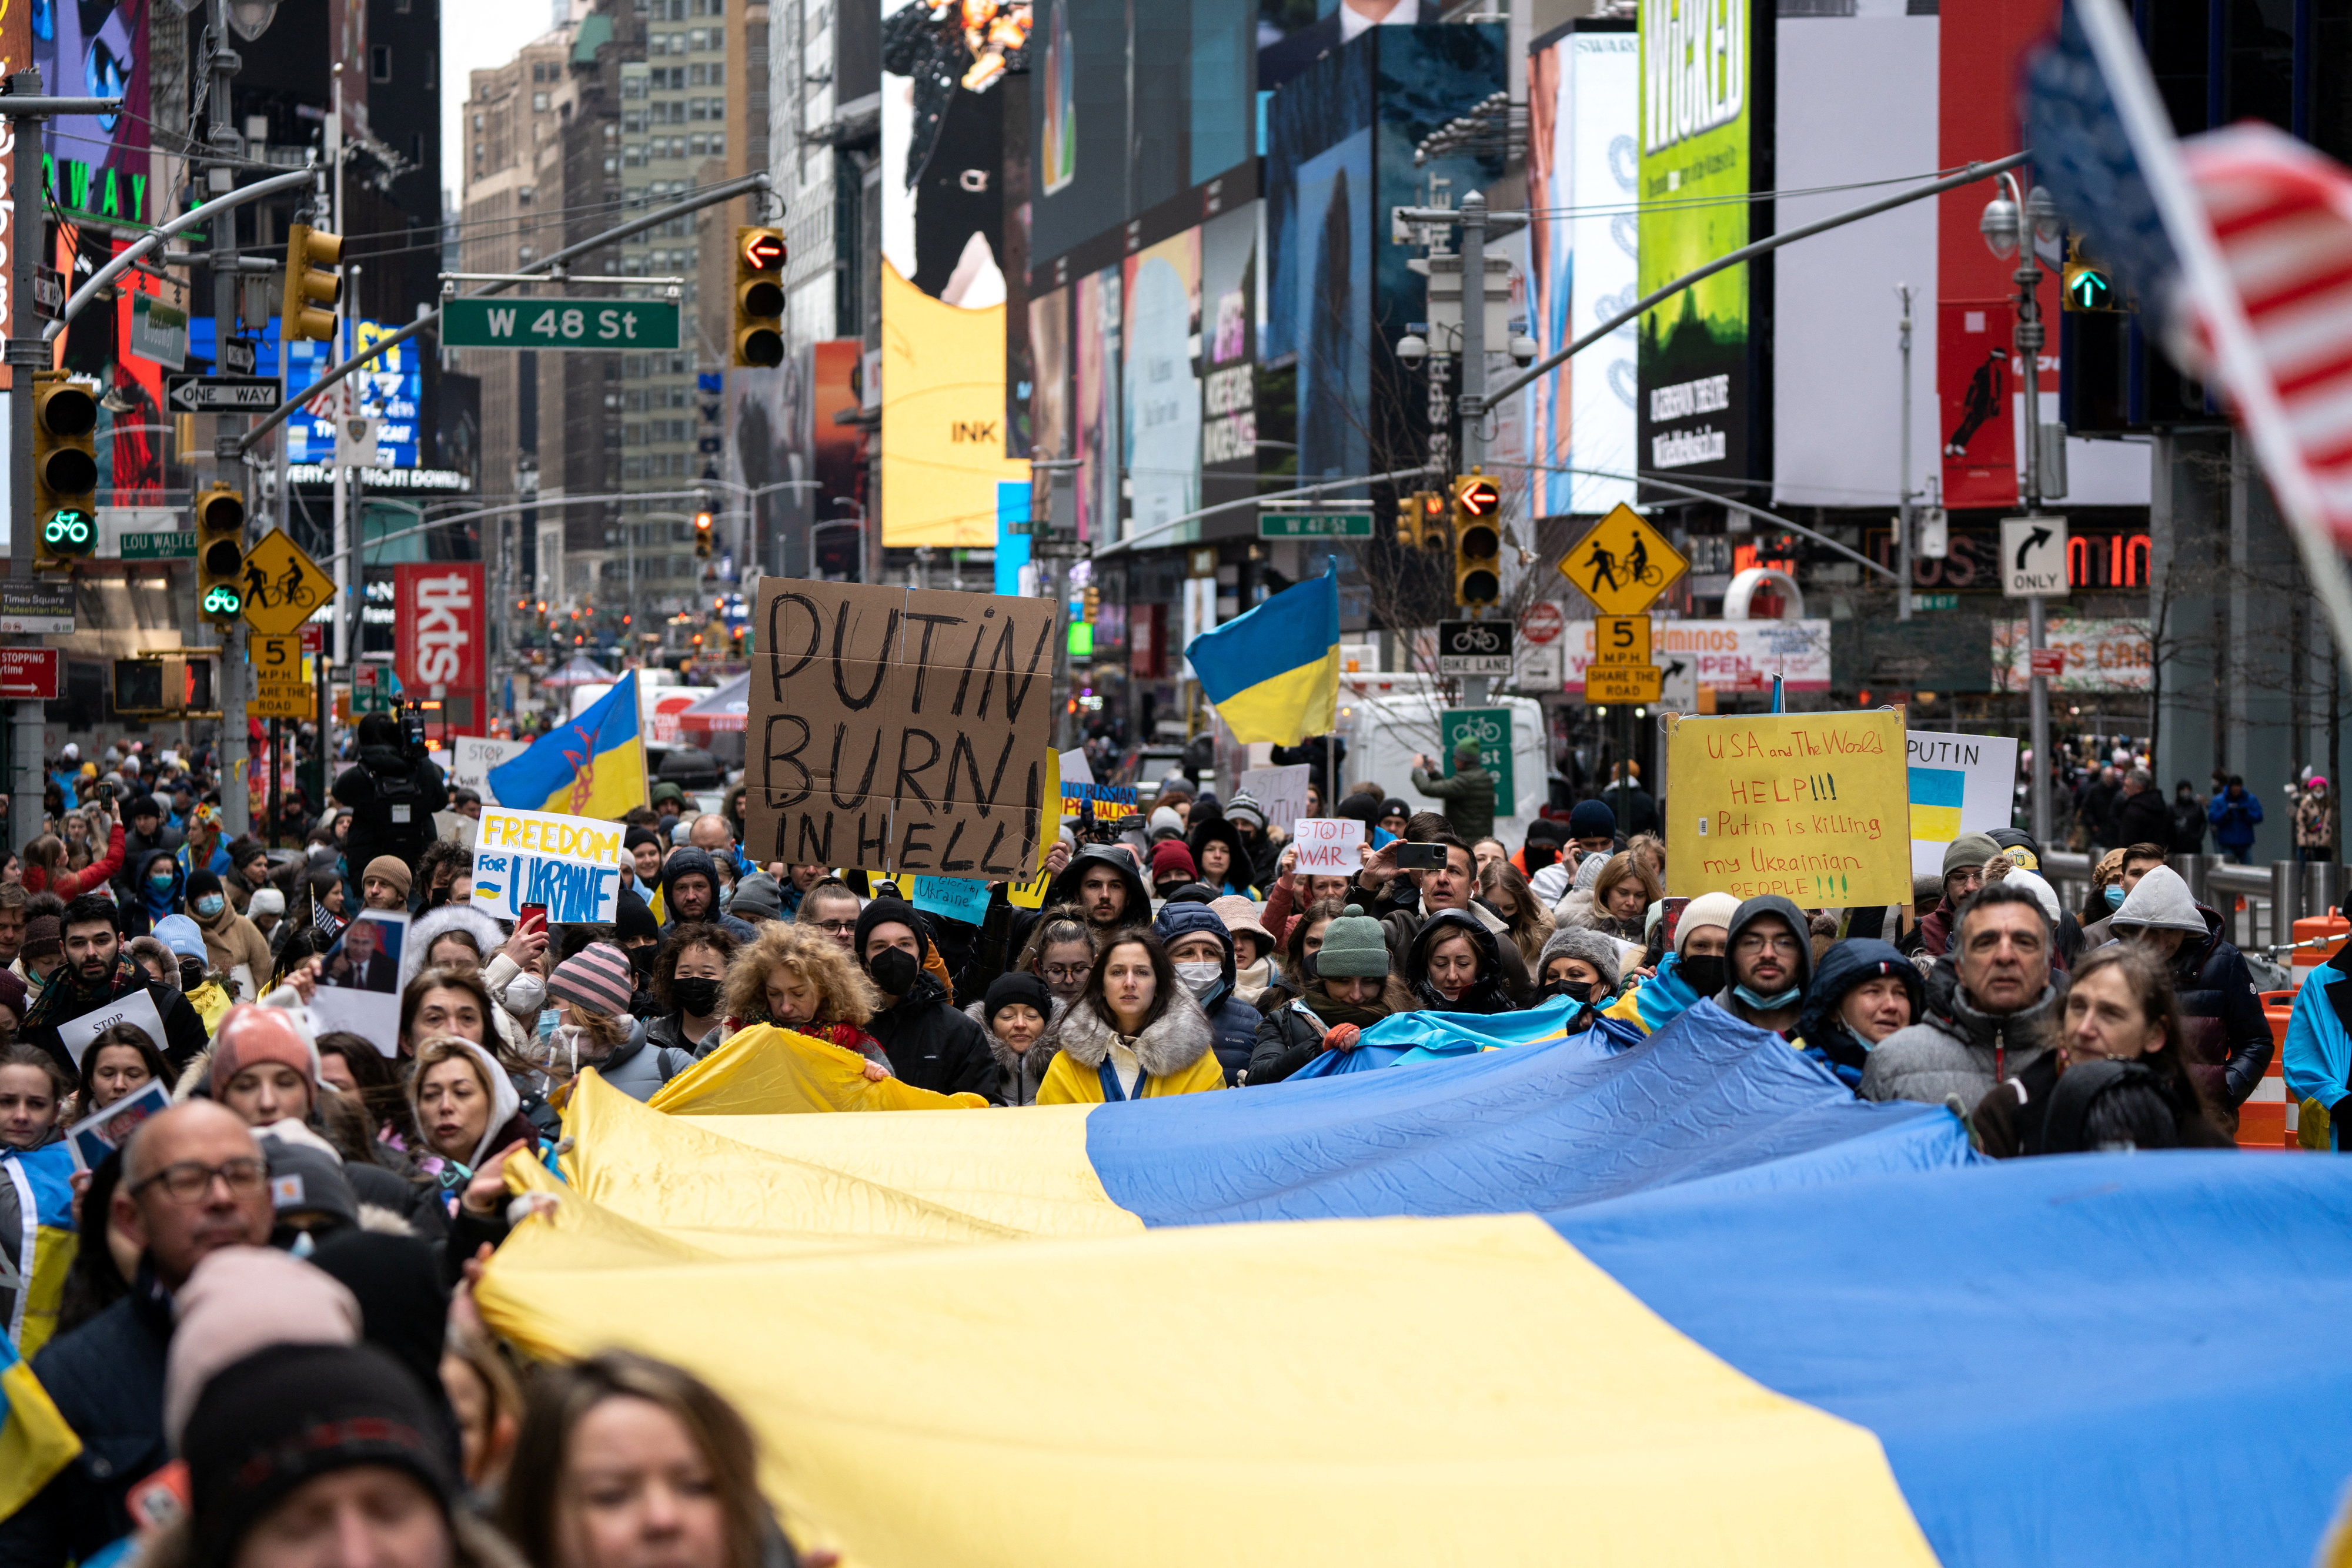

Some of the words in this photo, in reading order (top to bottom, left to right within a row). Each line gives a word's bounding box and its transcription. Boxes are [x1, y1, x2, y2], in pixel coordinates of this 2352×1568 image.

[487, 309, 516, 337] W
[531, 309, 584, 339] 48
[597, 310, 637, 339] St
[183, 387, 216, 401] ONE
[236, 387, 271, 401] WAY
[951, 421, 997, 443] INK
[123, 534, 147, 550] LOU
[2015, 574, 2057, 589] ONLY
[3, 604, 49, 614] Pedestrian
[51, 606, 72, 614] Plaza
[4, 594, 31, 604] Times
[32, 594, 65, 605] Square
[417, 572, 472, 684] tkts
[1613, 621, 1634, 647] 5
[1651, 628, 1738, 651] AMINOS
[2, 653, 45, 664] STOPPING
[266, 640, 285, 665] 5
[1443, 657, 1470, 671] BIKE
[1476, 657, 1509, 671] LANE
[1590, 670, 1629, 683] SHARE
[1634, 670, 1656, 683] THE
[260, 687, 280, 698] ARE
[286, 687, 306, 698] THE
[1605, 685, 1640, 696] ROAD
[259, 700, 291, 711] ROAD
[469, 743, 503, 761] STOP
[1707, 731, 1764, 759] USA
[1769, 744, 1792, 757] and
[1792, 731, 1821, 757] The
[1907, 741, 1979, 765] PUTIN
[1065, 781, 1082, 798] TO
[1085, 783, 1137, 805] RUSSIAN
[1254, 770, 1305, 795] STOP
[1730, 772, 1836, 805] HELP!!!
[1297, 821, 1355, 840] STOP
[1718, 810, 1775, 837] Putin
[1786, 819, 1805, 835] is
[483, 815, 620, 864] FREEDOM
[776, 812, 836, 865] IN
[1298, 843, 1347, 866] WAR
[1703, 857, 1740, 875] my
[478, 854, 507, 874] FOR
[509, 855, 619, 923] UKRAINE
[938, 877, 968, 892] Glory
[93, 1013, 123, 1034] STOP
